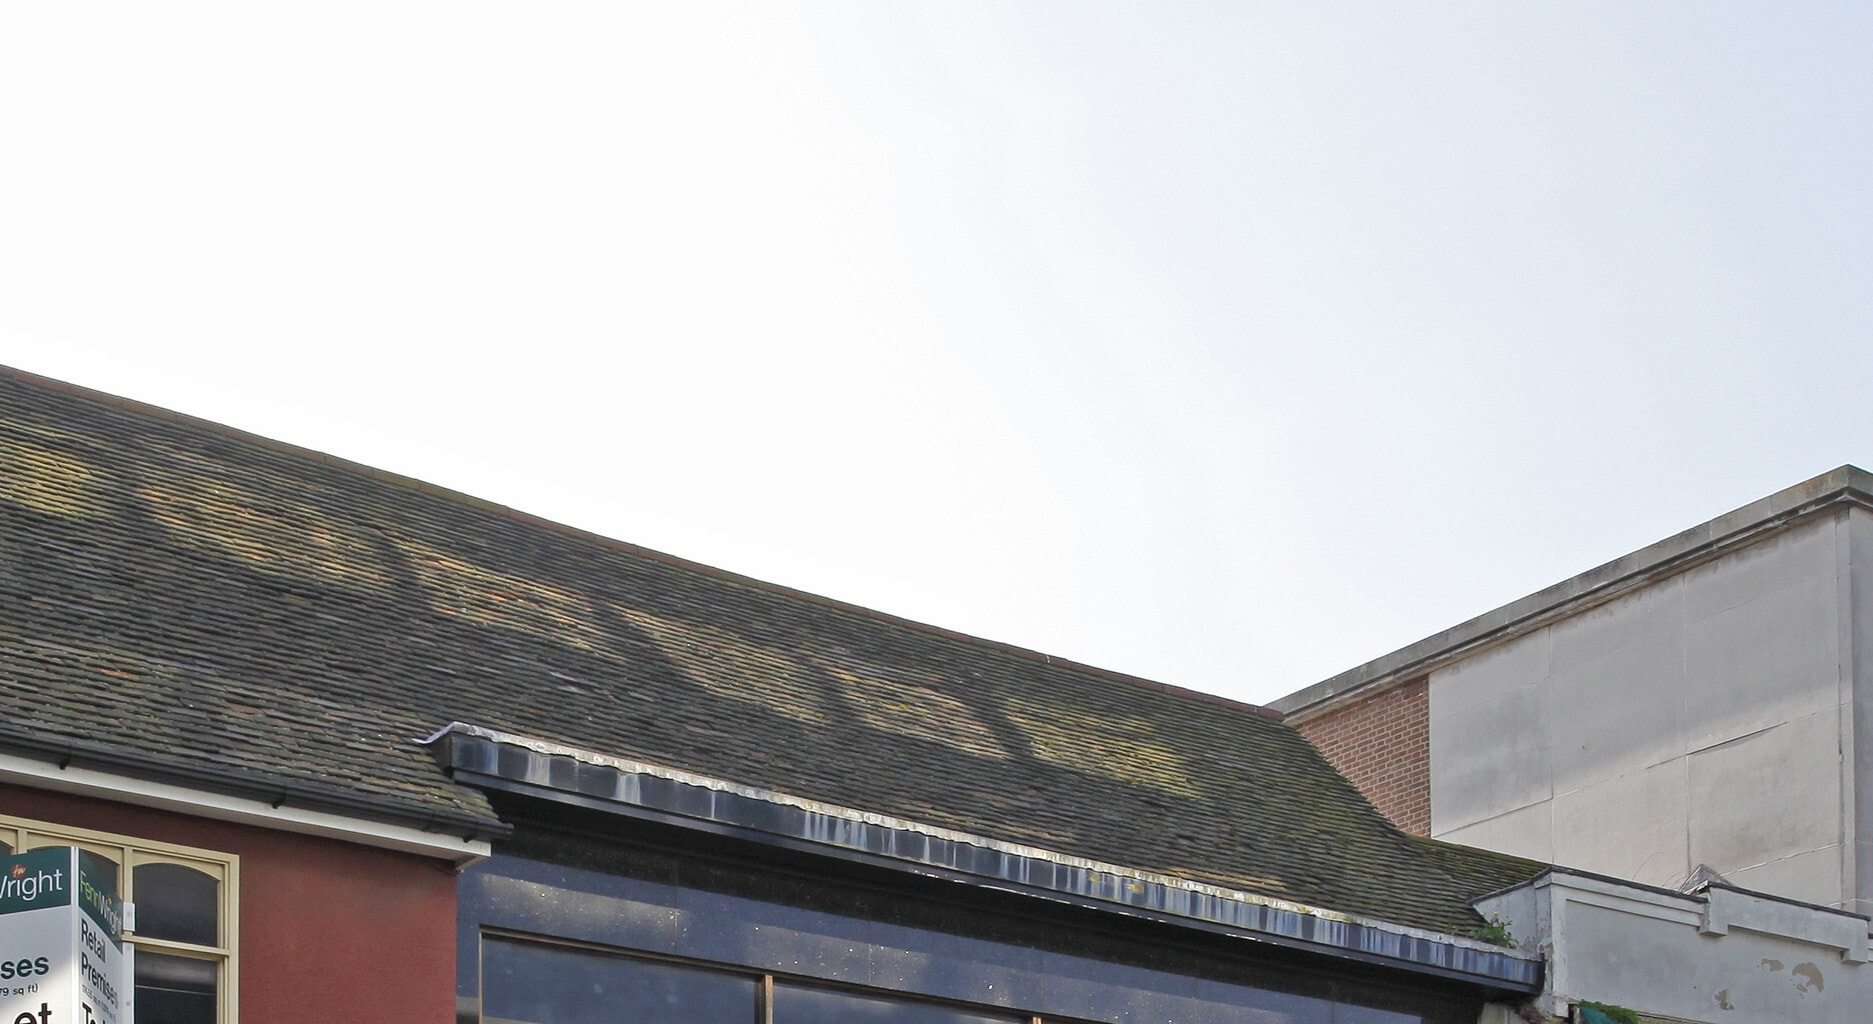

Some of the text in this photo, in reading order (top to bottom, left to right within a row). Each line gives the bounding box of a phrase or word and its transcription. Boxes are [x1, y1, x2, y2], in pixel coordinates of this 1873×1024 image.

[0, 869, 63, 901] right
[81, 919, 106, 963] Retail
[81, 951, 118, 1009] Premises
